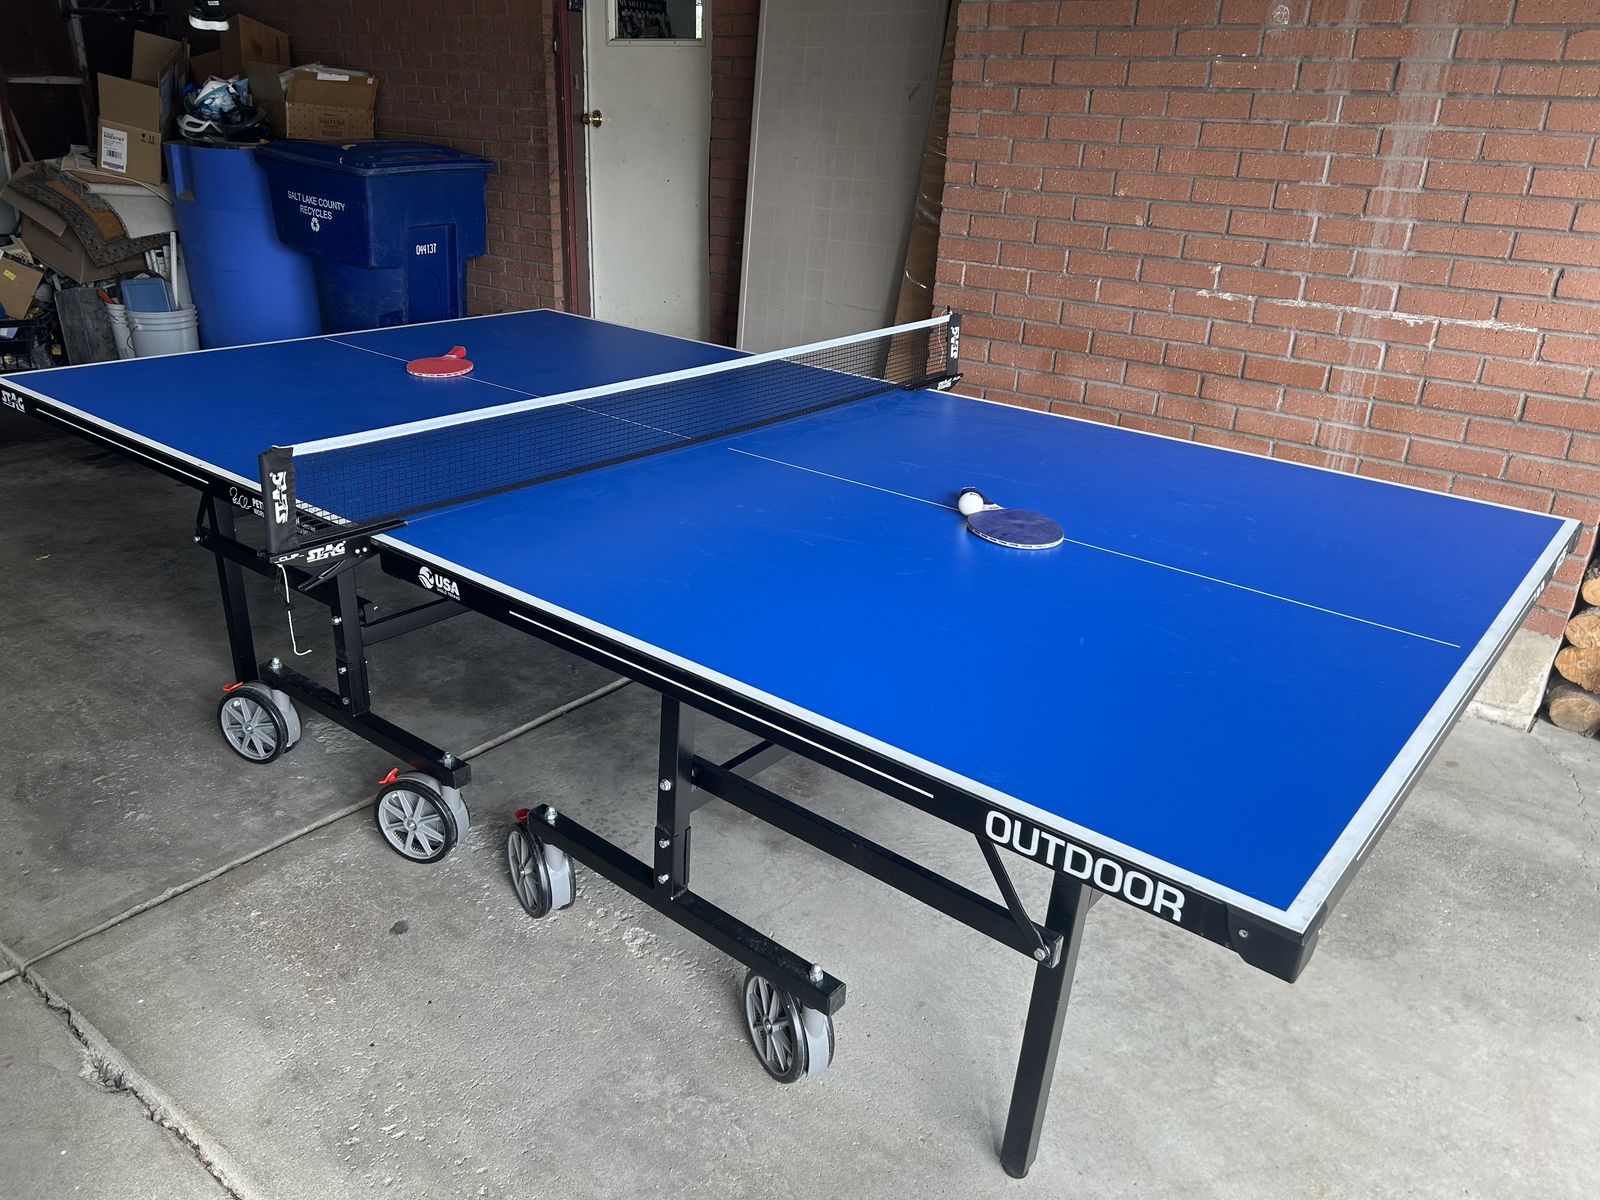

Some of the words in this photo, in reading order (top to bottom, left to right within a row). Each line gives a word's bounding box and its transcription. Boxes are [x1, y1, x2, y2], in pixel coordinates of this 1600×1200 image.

[287, 190, 301, 201] SALT
[301, 194, 317, 206] LAKE
[318, 198, 345, 211] COUNTY
[300, 204, 333, 220] RECYCLES
[415, 243, 437, 256] 044137
[1, 390, 26, 413] STAG
[269, 471, 289, 524] STAG
[306, 540, 347, 563] STAG
[434, 573, 460, 597] USA
[985, 810, 1185, 923] OUTDOOR
